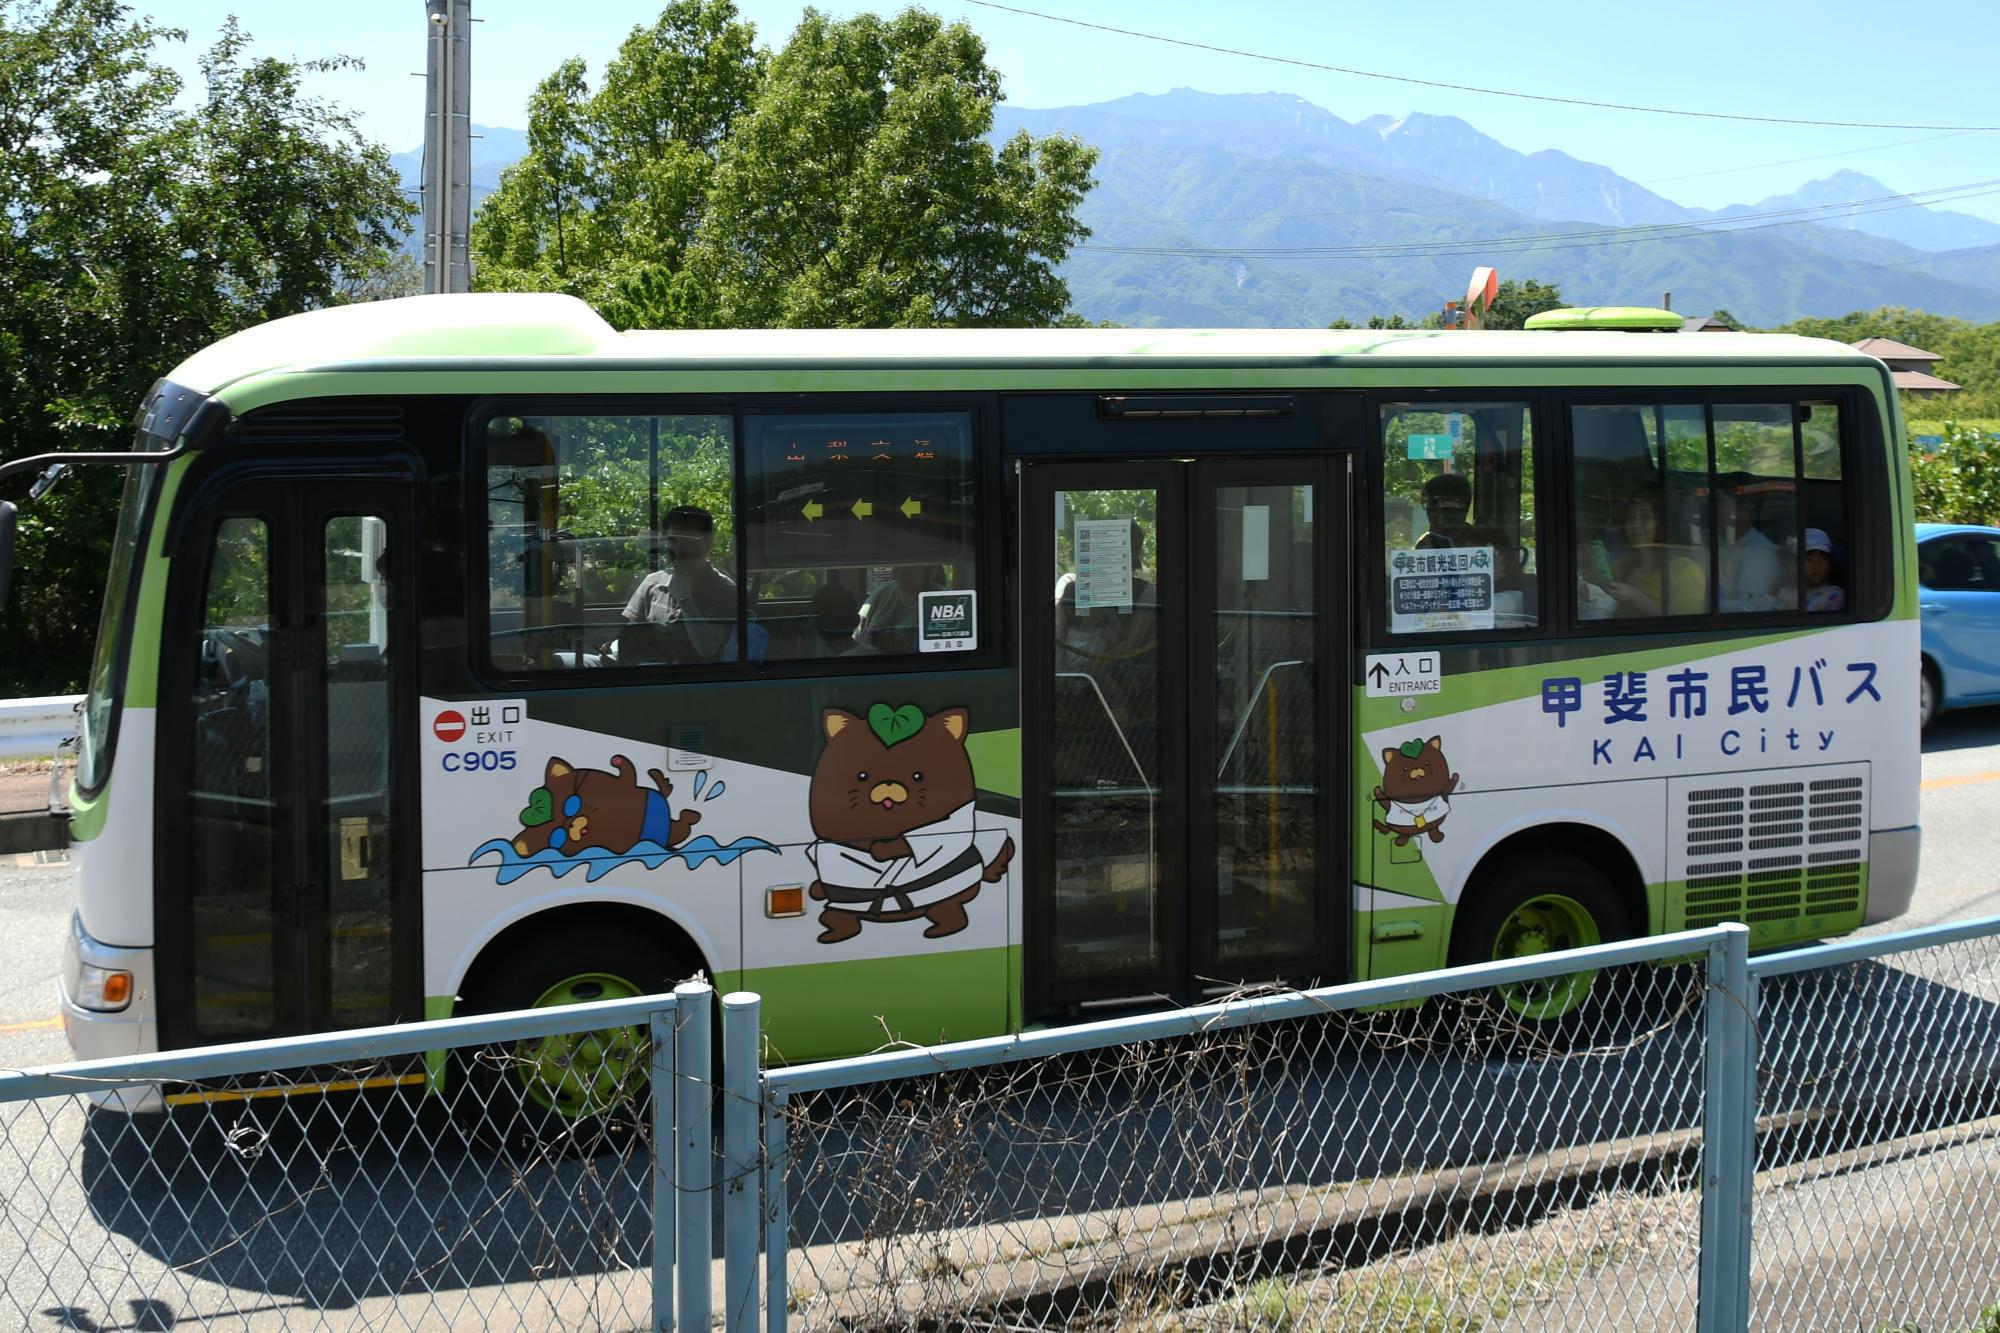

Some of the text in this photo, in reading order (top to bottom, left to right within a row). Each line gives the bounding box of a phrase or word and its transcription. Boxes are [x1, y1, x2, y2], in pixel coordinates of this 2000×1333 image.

[930, 605, 965, 618] NBA
[1395, 658, 1432, 675] 入口
[1389, 680, 1439, 692] ENTRANCE
[1542, 658, 1881, 728] 甲斐市民バス
[471, 706, 519, 725] 出口
[477, 731, 514, 743] EXIT
[1593, 728, 1834, 765] KAI City
[442, 750, 517, 772] C905
